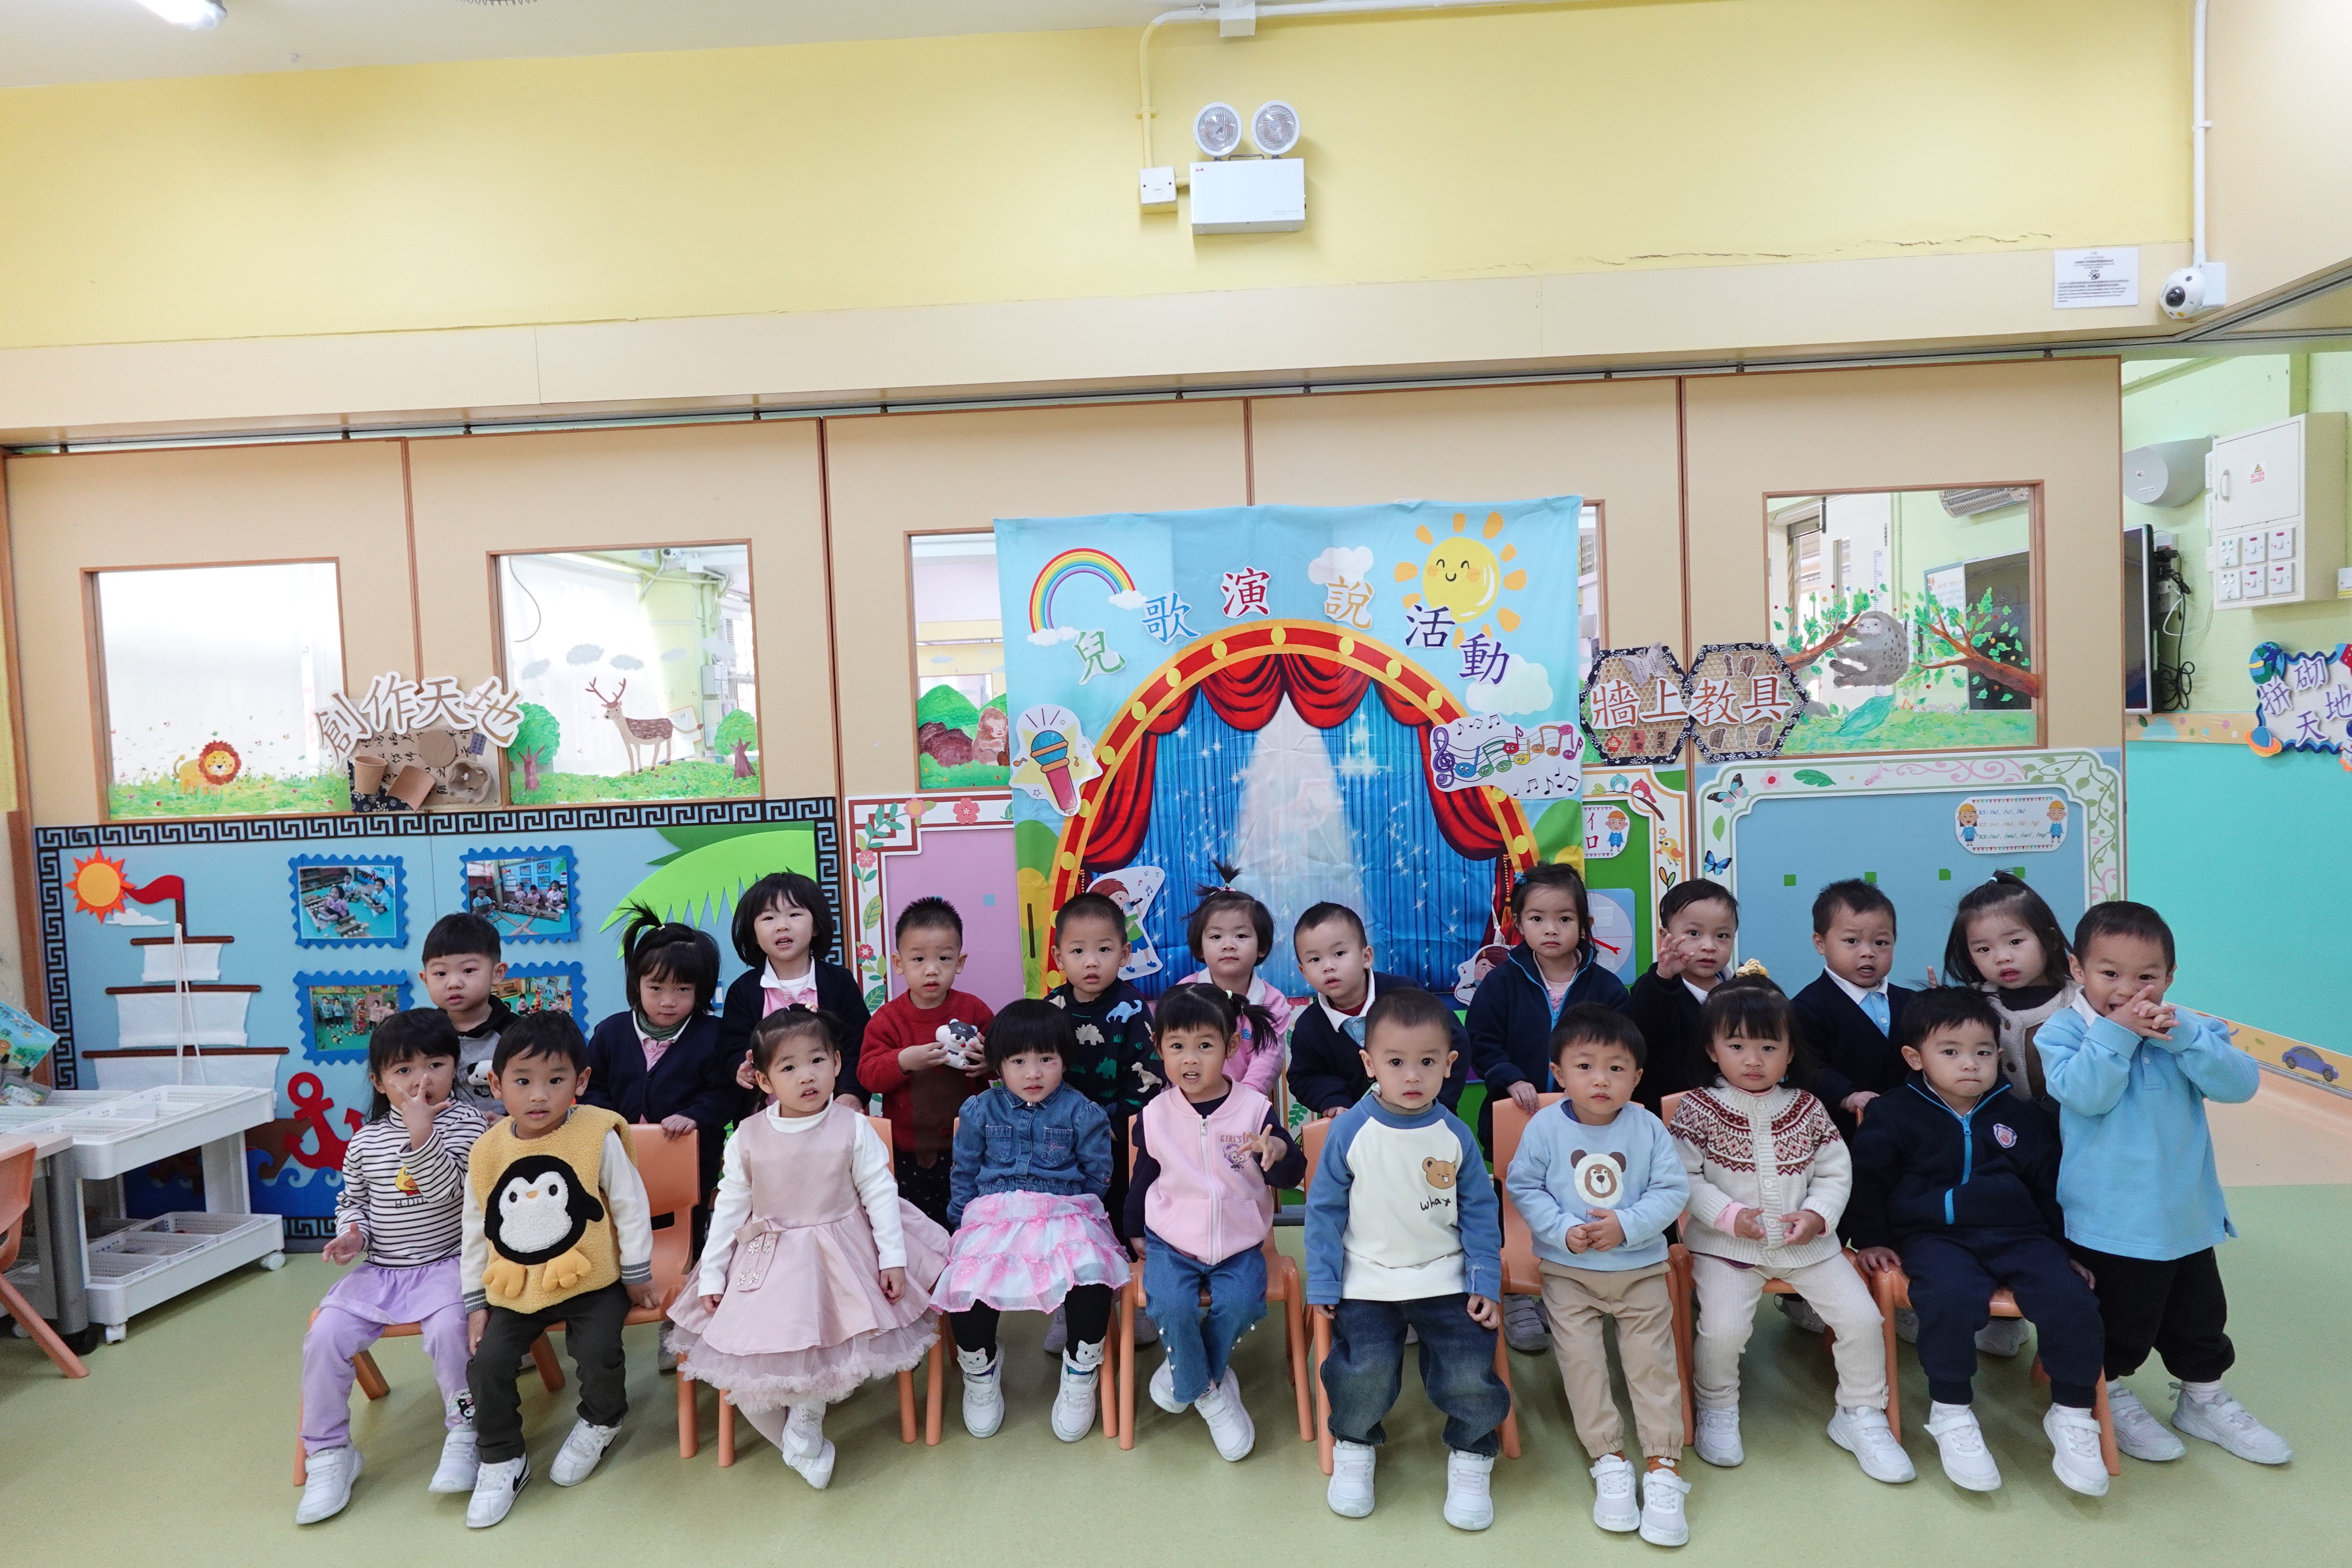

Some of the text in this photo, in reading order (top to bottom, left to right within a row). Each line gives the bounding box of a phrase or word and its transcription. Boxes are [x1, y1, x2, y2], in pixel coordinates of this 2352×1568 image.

[1075, 567, 1509, 684] 兒歌演說活動
[316, 675, 521, 760] 創作天地
[1593, 677, 1791, 727] 牆上教具
[1221, 1135, 1242, 1143] GIRL'S
